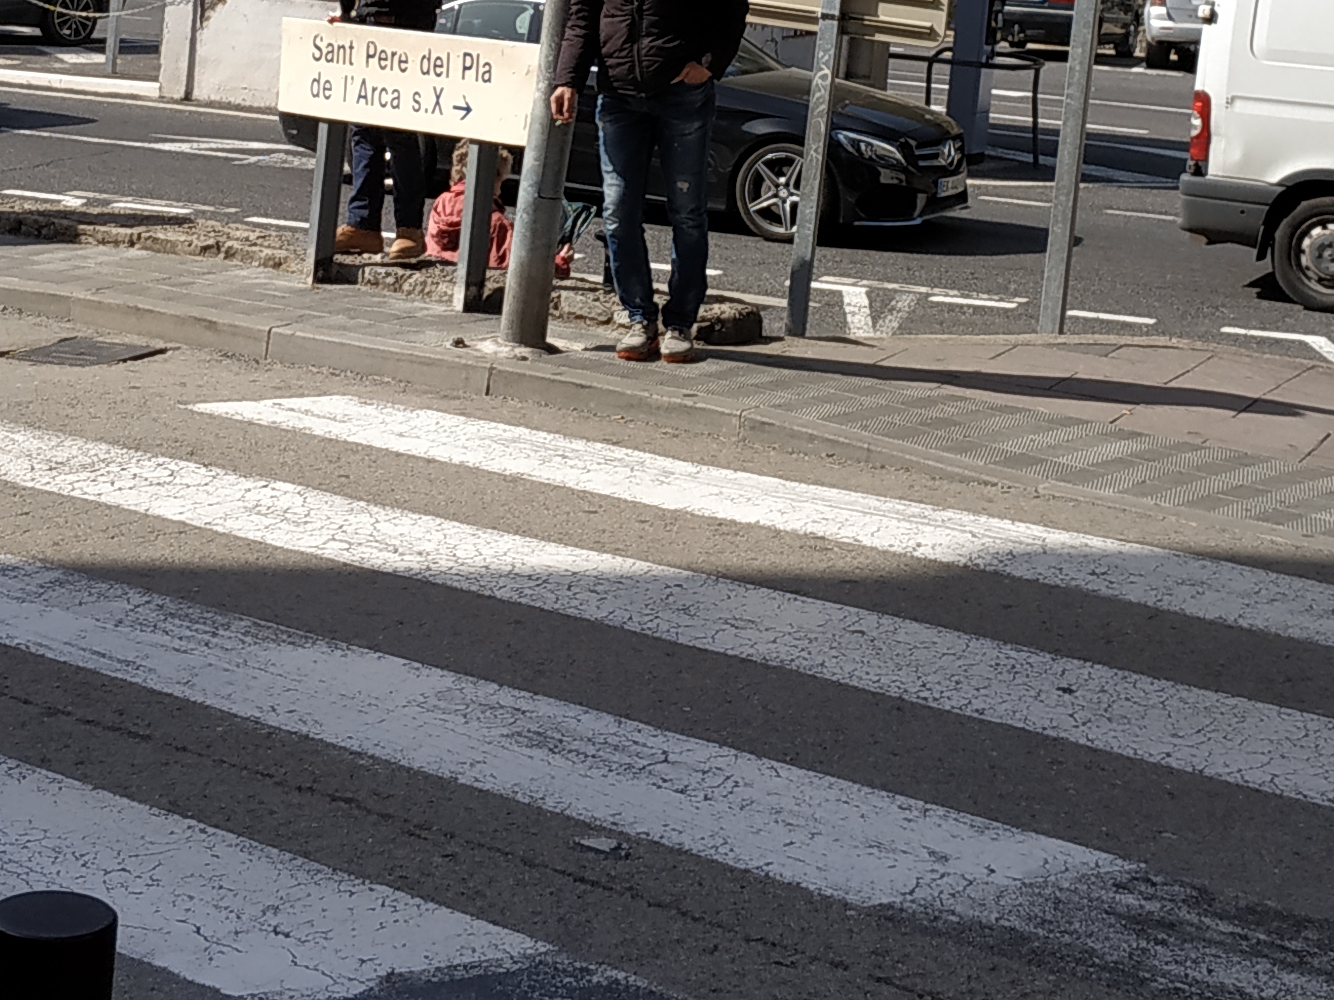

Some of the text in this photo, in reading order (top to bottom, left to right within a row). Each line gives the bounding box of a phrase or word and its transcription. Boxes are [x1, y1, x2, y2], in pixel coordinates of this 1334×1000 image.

[311, 33, 493, 84] Sant Pere del Pla
[310, 71, 445, 116] de l'Arca s.X
